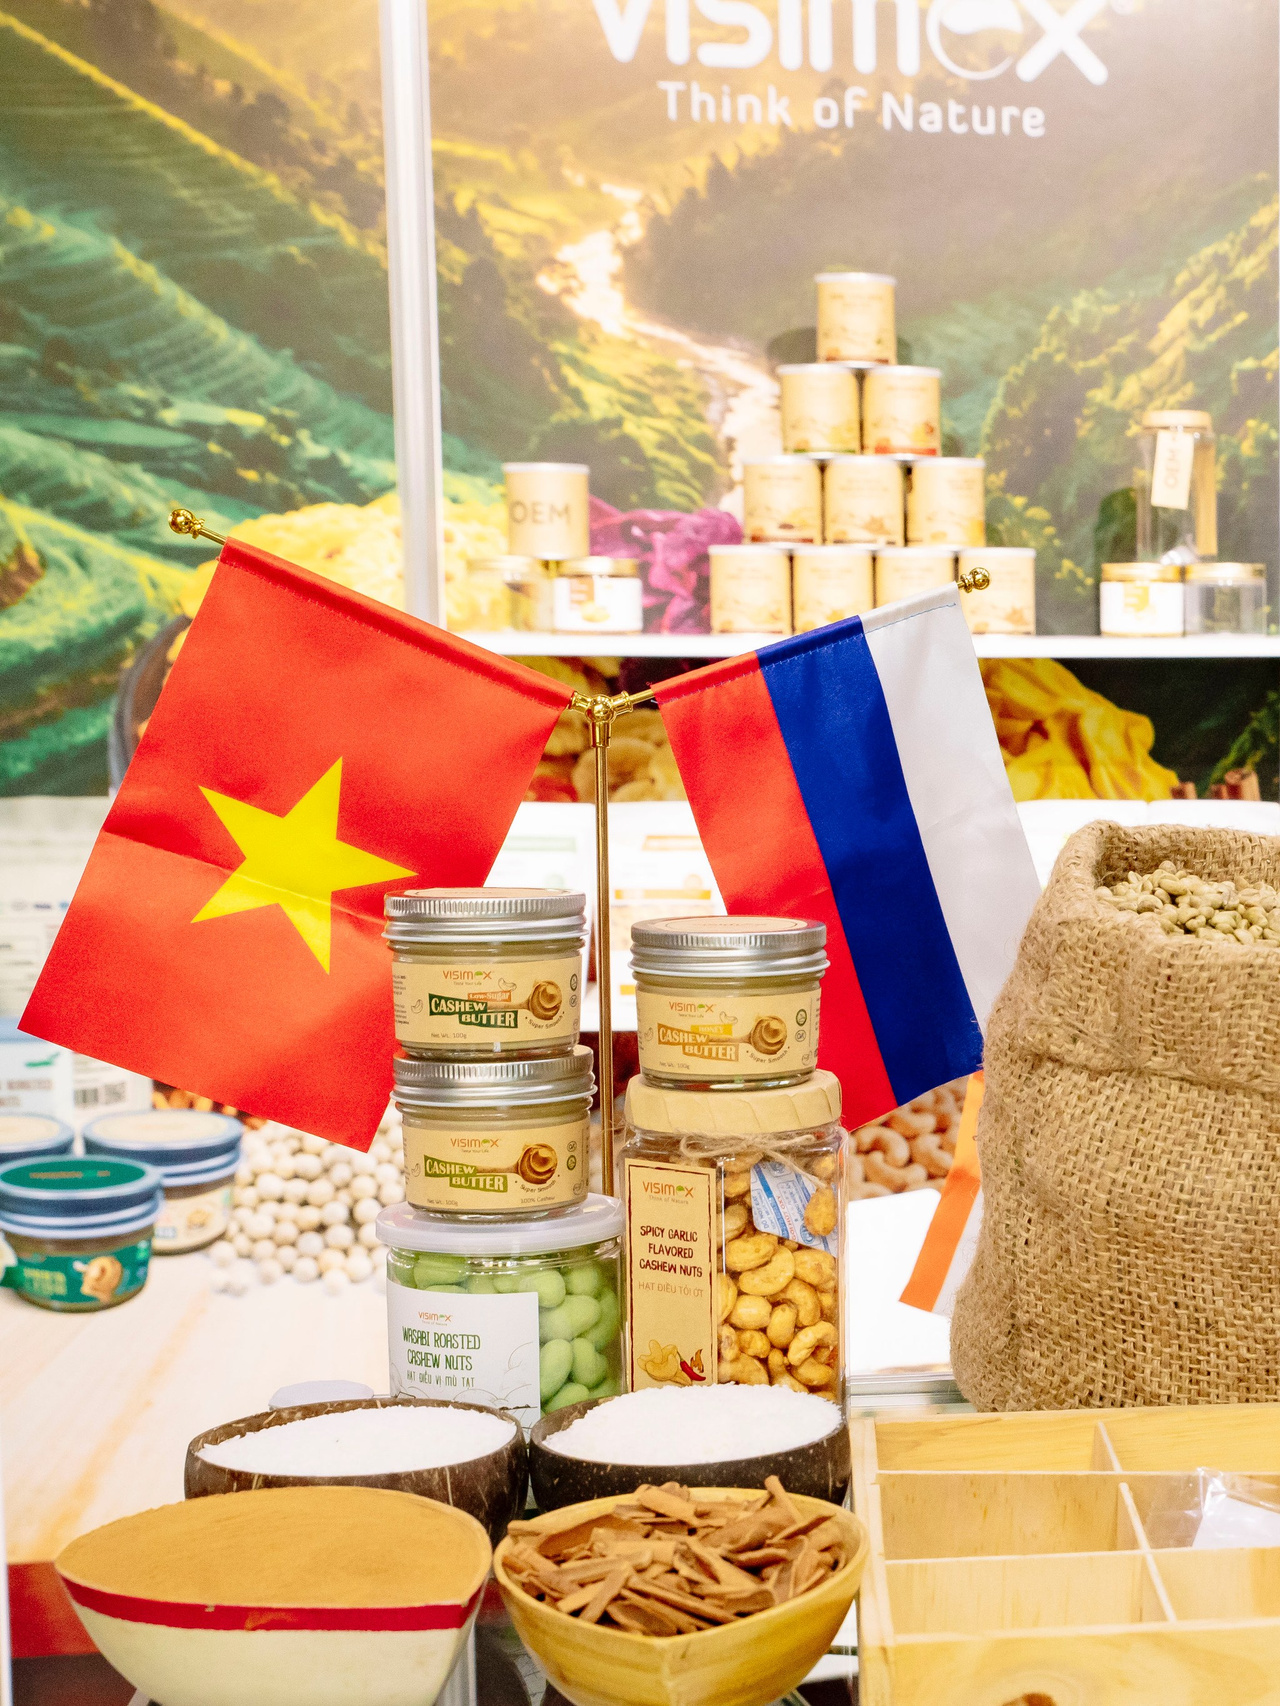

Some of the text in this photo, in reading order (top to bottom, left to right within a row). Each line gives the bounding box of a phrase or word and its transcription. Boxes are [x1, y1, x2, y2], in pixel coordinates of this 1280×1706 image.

[657, 80, 1046, 138] Think of Nature
[508, 500, 572, 524] OEM
[431, 997, 487, 1013] CASHEW
[461, 1012, 515, 1028] BUTTER
[528, 1019, 544, 1029] Super
[659, 1028, 708, 1043] CASHEW
[685, 1044, 736, 1061] BUTTER
[750, 1050, 788, 1064] Super Smooth
[426, 1160, 476, 1175] CASHEW
[452, 1176, 504, 1191] BUTTER
[520, 1184, 536, 1193] Super
[640, 1225, 698, 1242] SPICY GARLIC
[648, 1243, 694, 1259] FLAVORED
[639, 1258, 703, 1278] CASHEW NUTS
[402, 1326, 481, 1350] WASABI ROASTED
[407, 1349, 473, 1371] CASHEW NUTS
